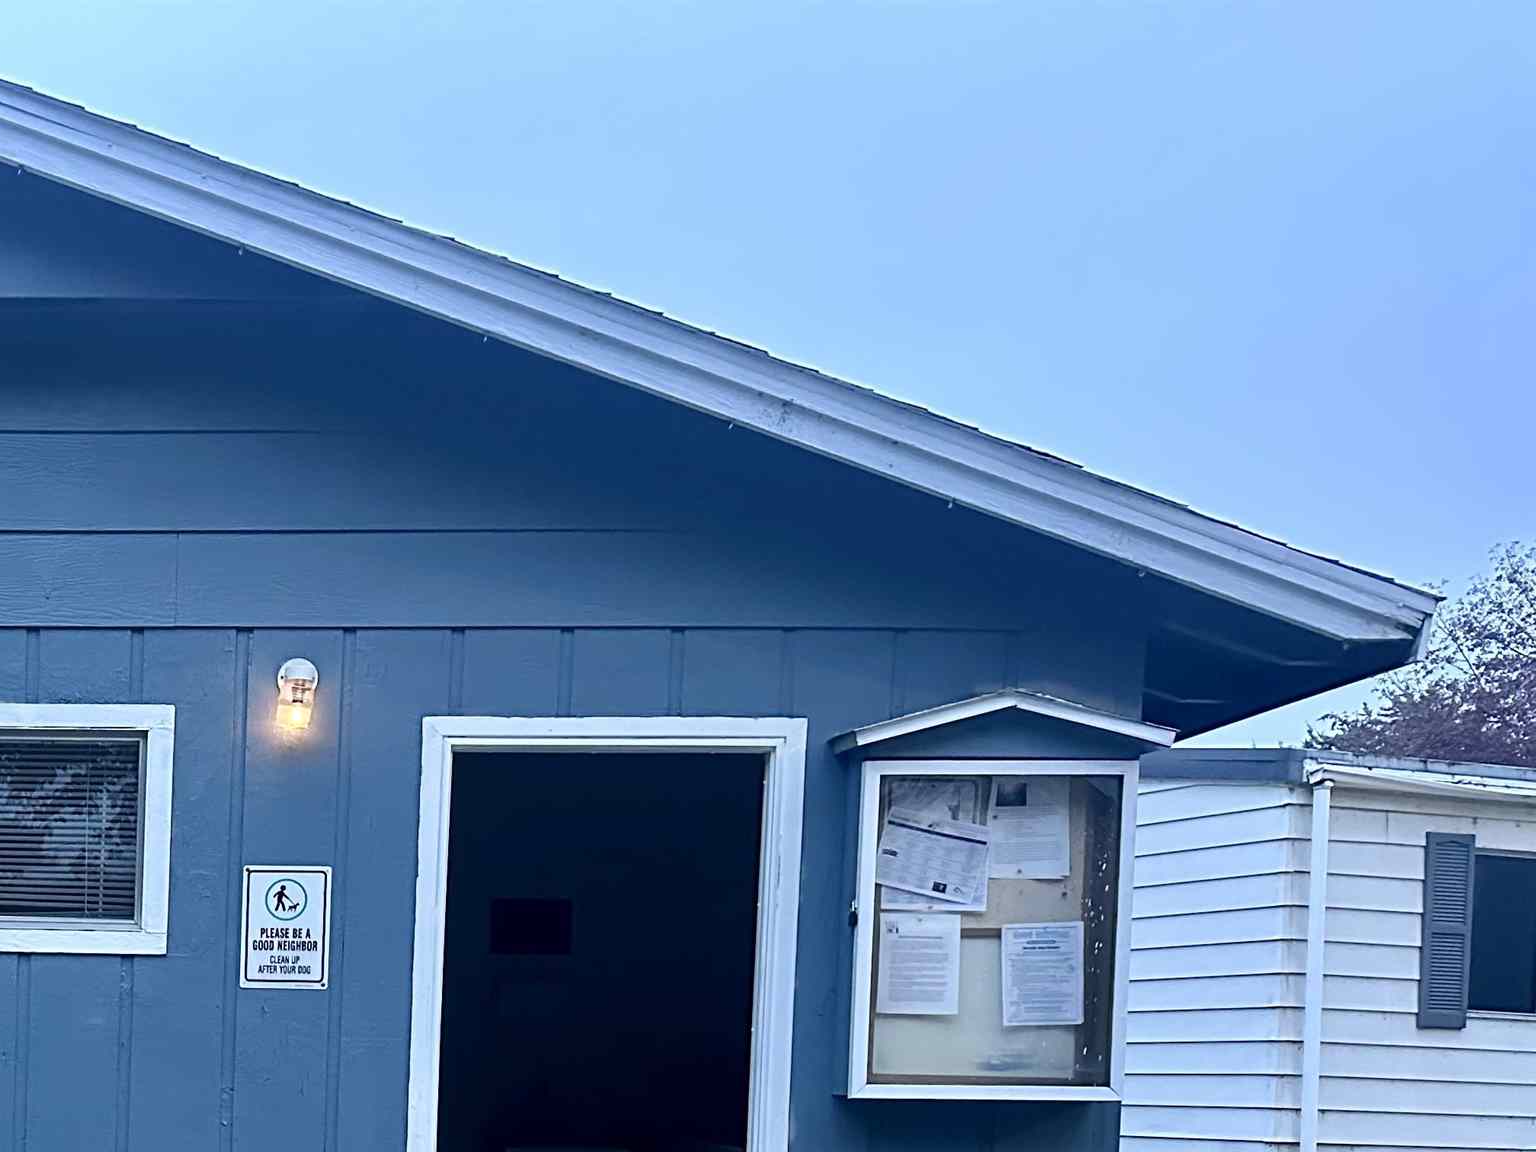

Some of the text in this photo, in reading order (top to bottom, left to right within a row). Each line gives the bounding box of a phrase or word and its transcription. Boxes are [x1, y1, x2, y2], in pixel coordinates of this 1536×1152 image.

[260, 928, 311, 939] PLEASE BE A
[252, 940, 318, 951] GOOD NEIGHBOR
[269, 955, 300, 965] CLEAN UP
[257, 965, 311, 974] AFTER YOUR DOG
